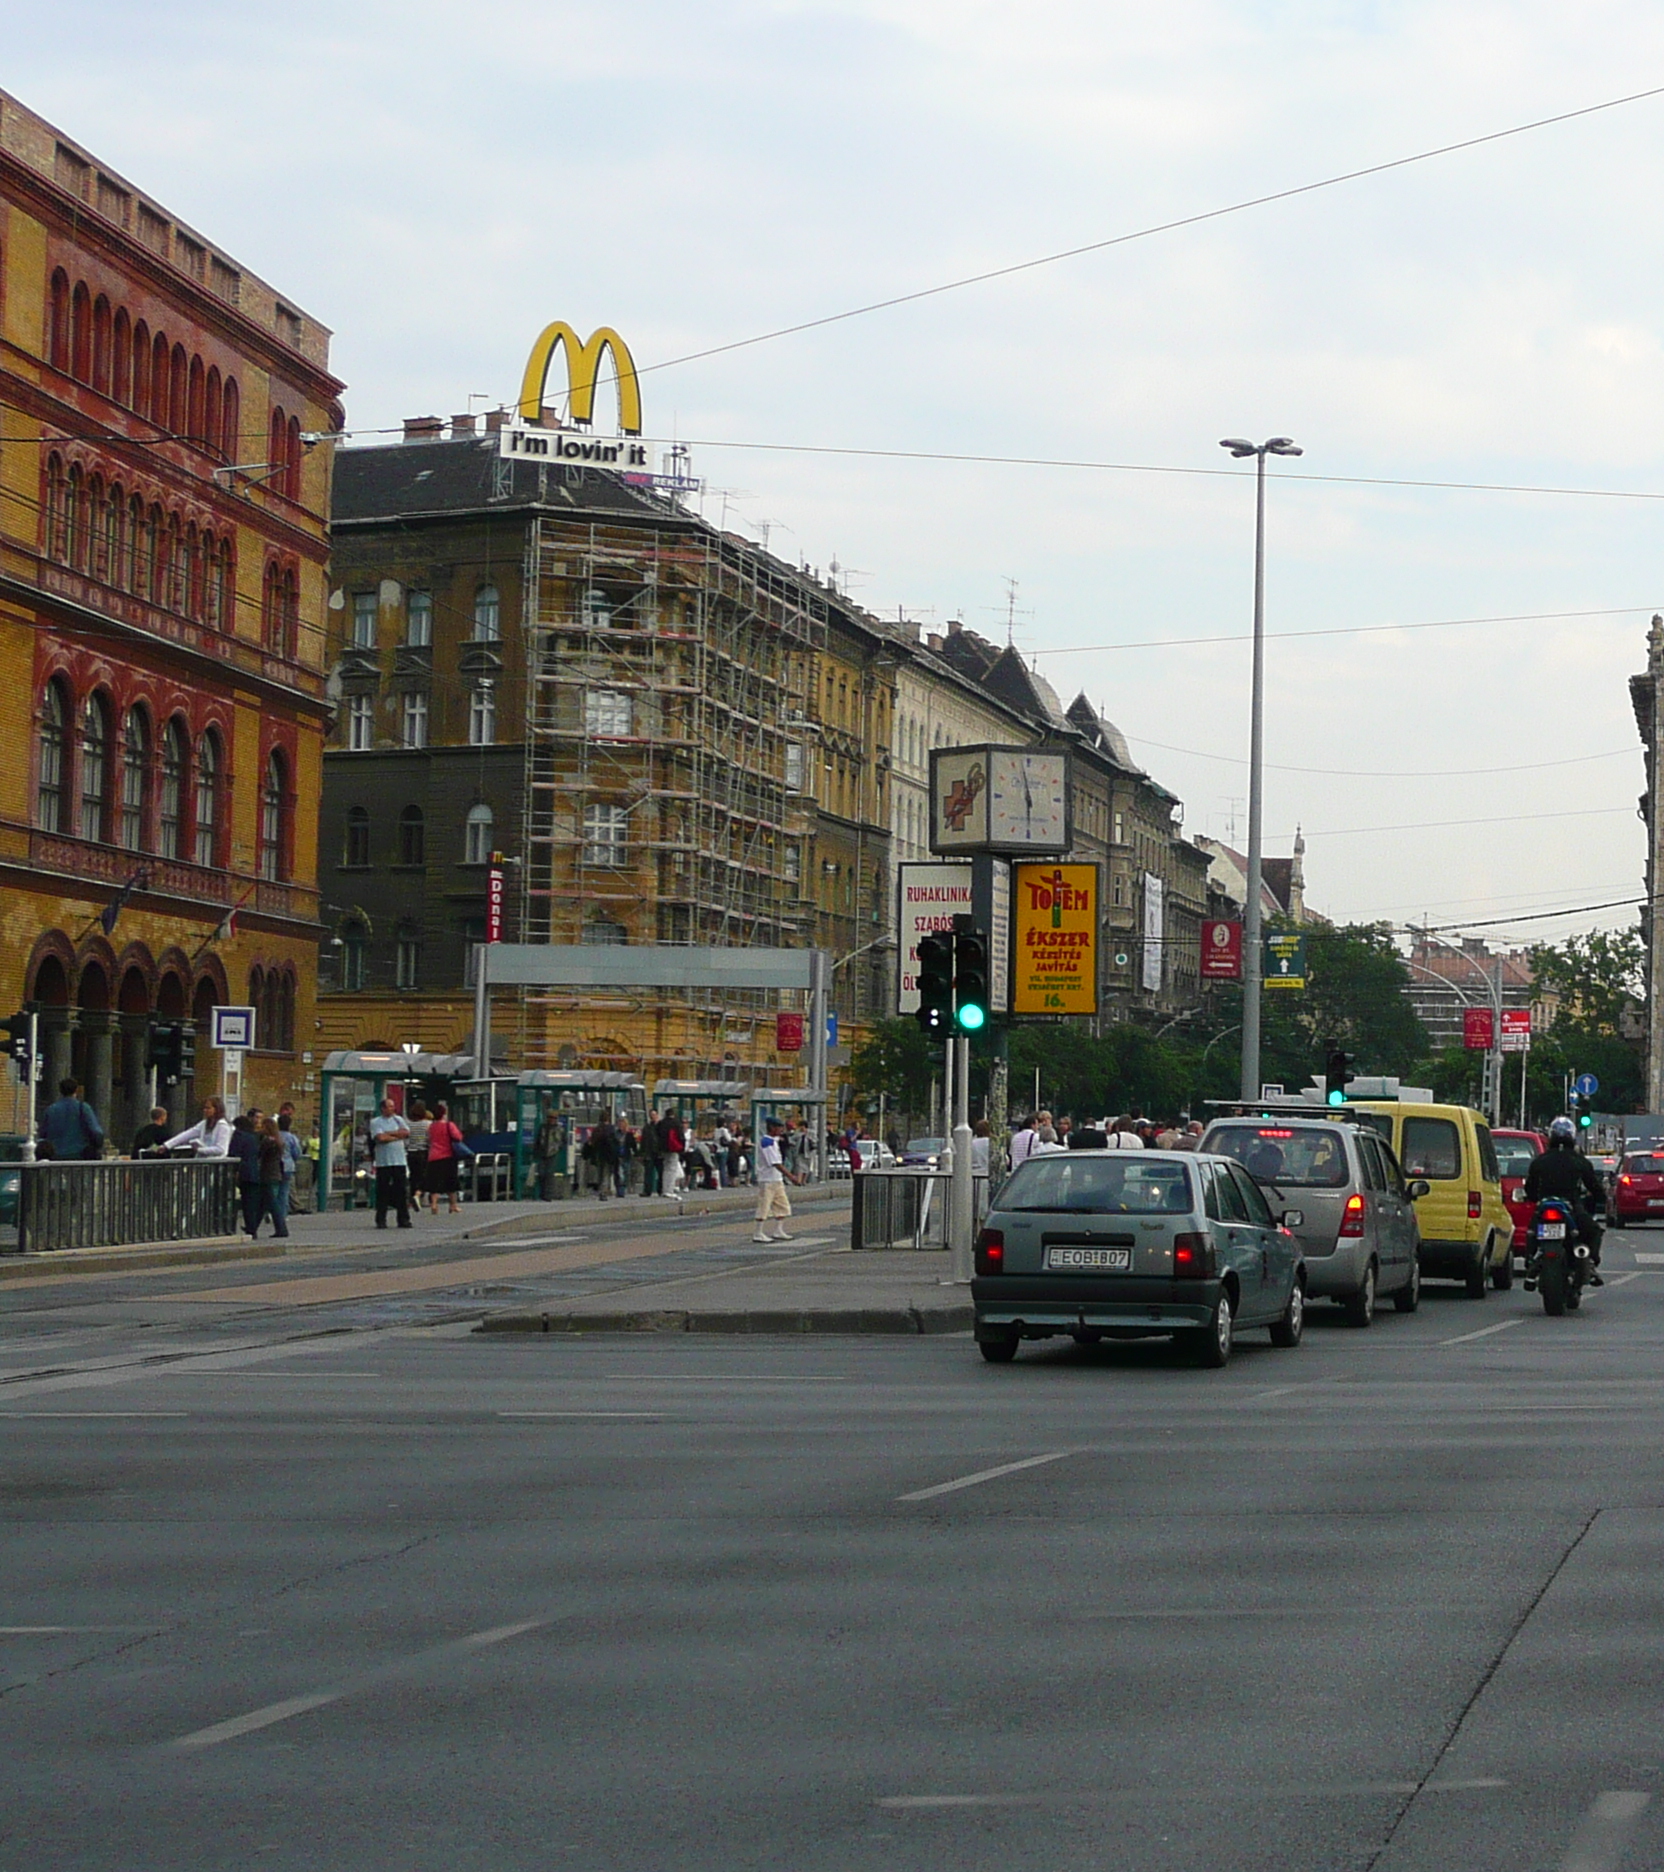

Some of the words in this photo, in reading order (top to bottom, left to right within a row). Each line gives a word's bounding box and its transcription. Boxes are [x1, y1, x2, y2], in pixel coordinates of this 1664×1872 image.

[511, 431, 548, 455] i'm
[557, 435, 624, 462] lovin'
[629, 444, 647, 466] it
[1024, 872, 1088, 920] TOTEM
[1026, 927, 1090, 947] ÉKSZER
[1035, 961, 1078, 972] JAVÍTÁS
